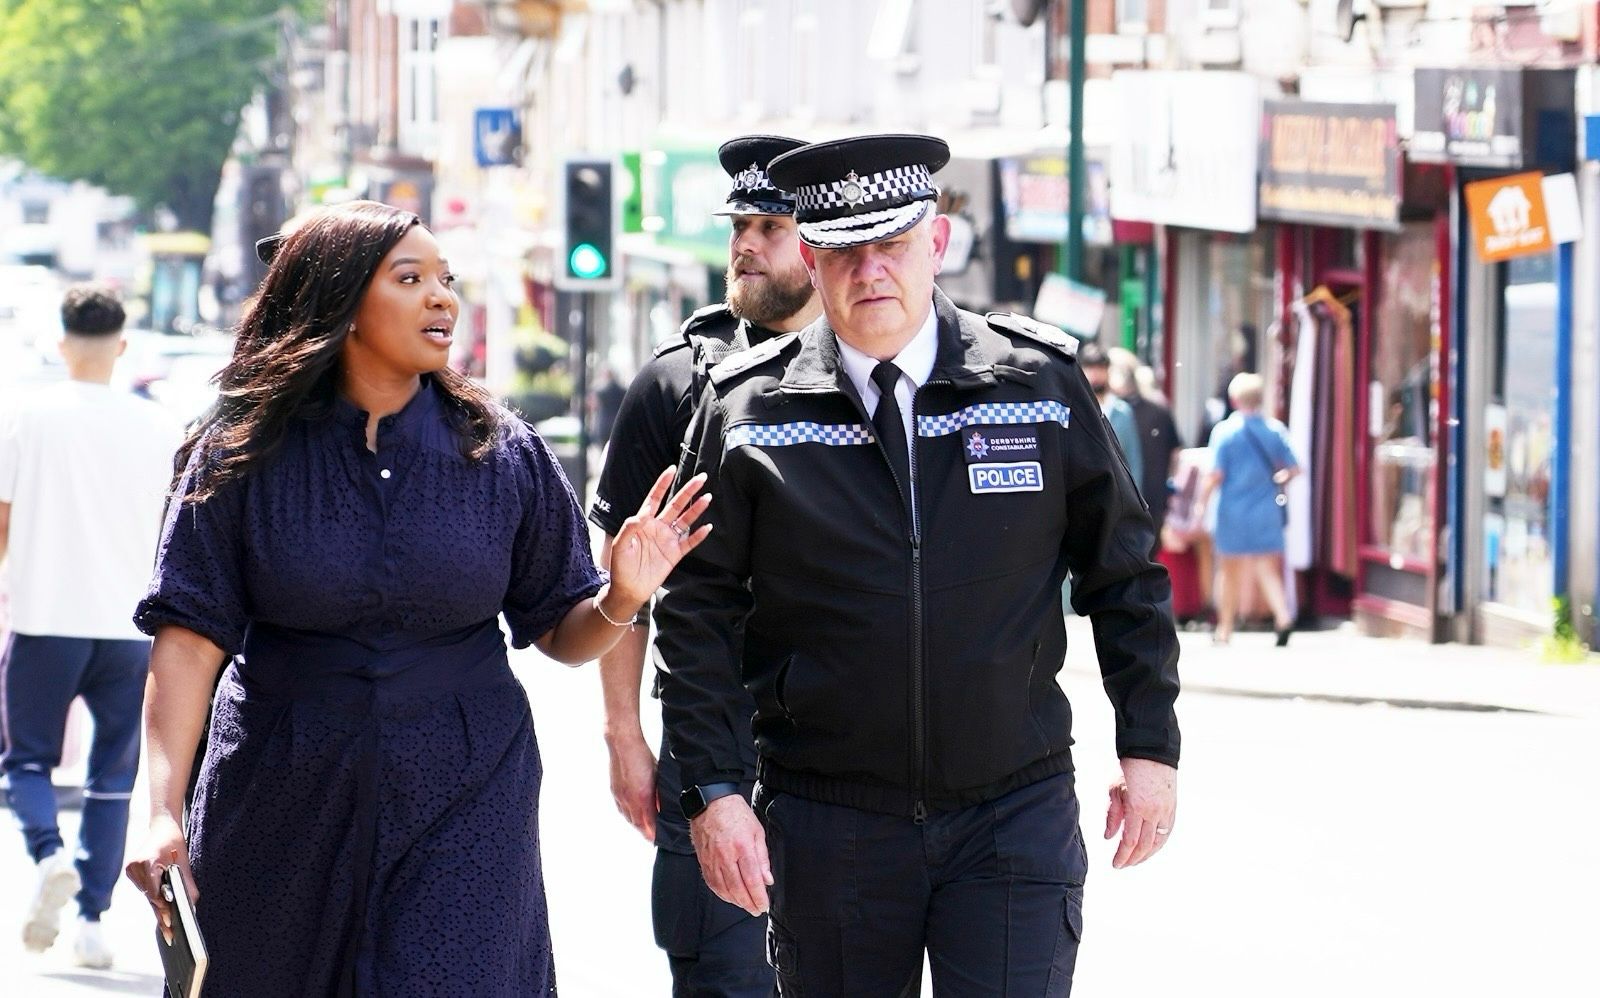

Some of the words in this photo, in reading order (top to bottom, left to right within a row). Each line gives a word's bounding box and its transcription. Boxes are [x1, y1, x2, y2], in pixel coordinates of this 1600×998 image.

[990, 437, 1037, 445] DERBYSHIRE
[990, 443, 1037, 451] CONSTABULARY
[976, 468, 1037, 487] POLICE
